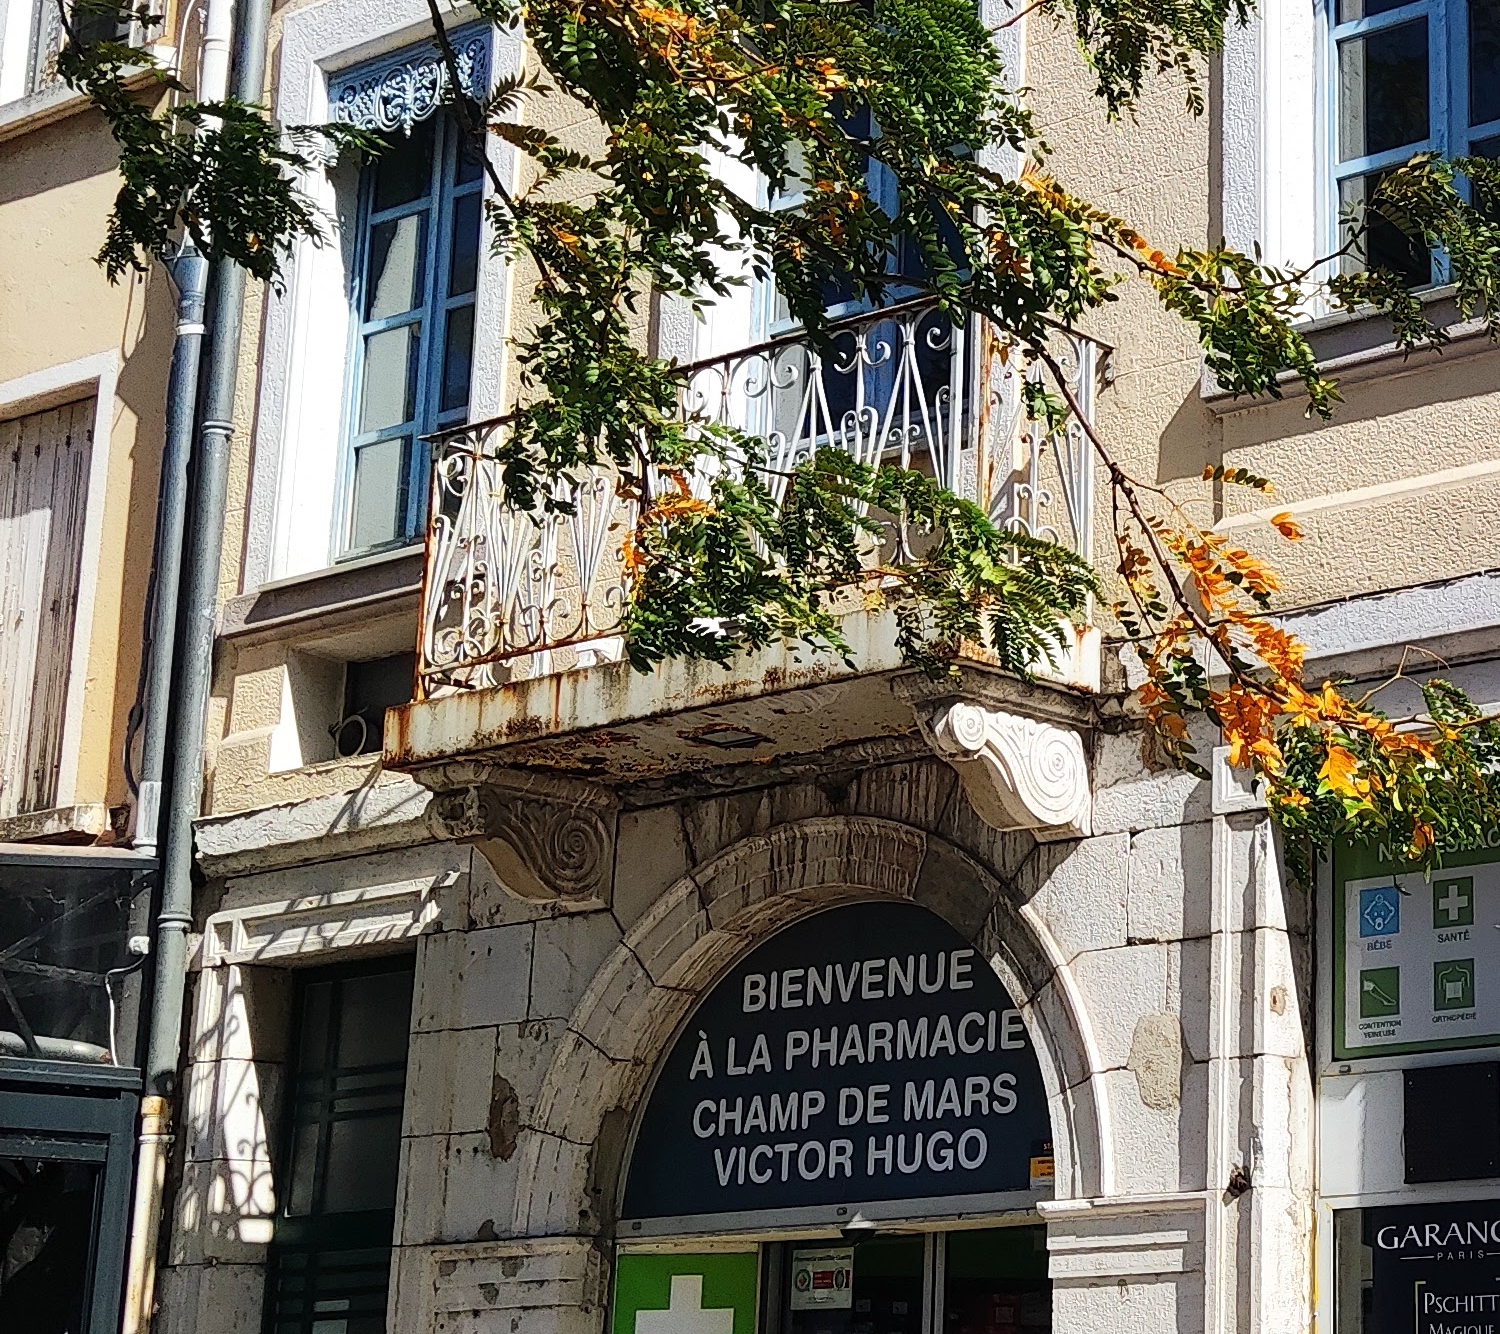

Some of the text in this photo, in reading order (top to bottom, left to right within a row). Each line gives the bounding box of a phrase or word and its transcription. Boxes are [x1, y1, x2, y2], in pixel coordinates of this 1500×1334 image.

[1437, 929, 1471, 943] SANTÉ
[742, 949, 975, 1012] BIENVENUE
[689, 1008, 1026, 1080] À LA PHARMACIE
[692, 1073, 1018, 1138] CHAMP DE MARS
[714, 1139, 853, 1186] VICTOR
[867, 1128, 988, 1176] HUGO
[1437, 1249, 1485, 1261] PARIS
